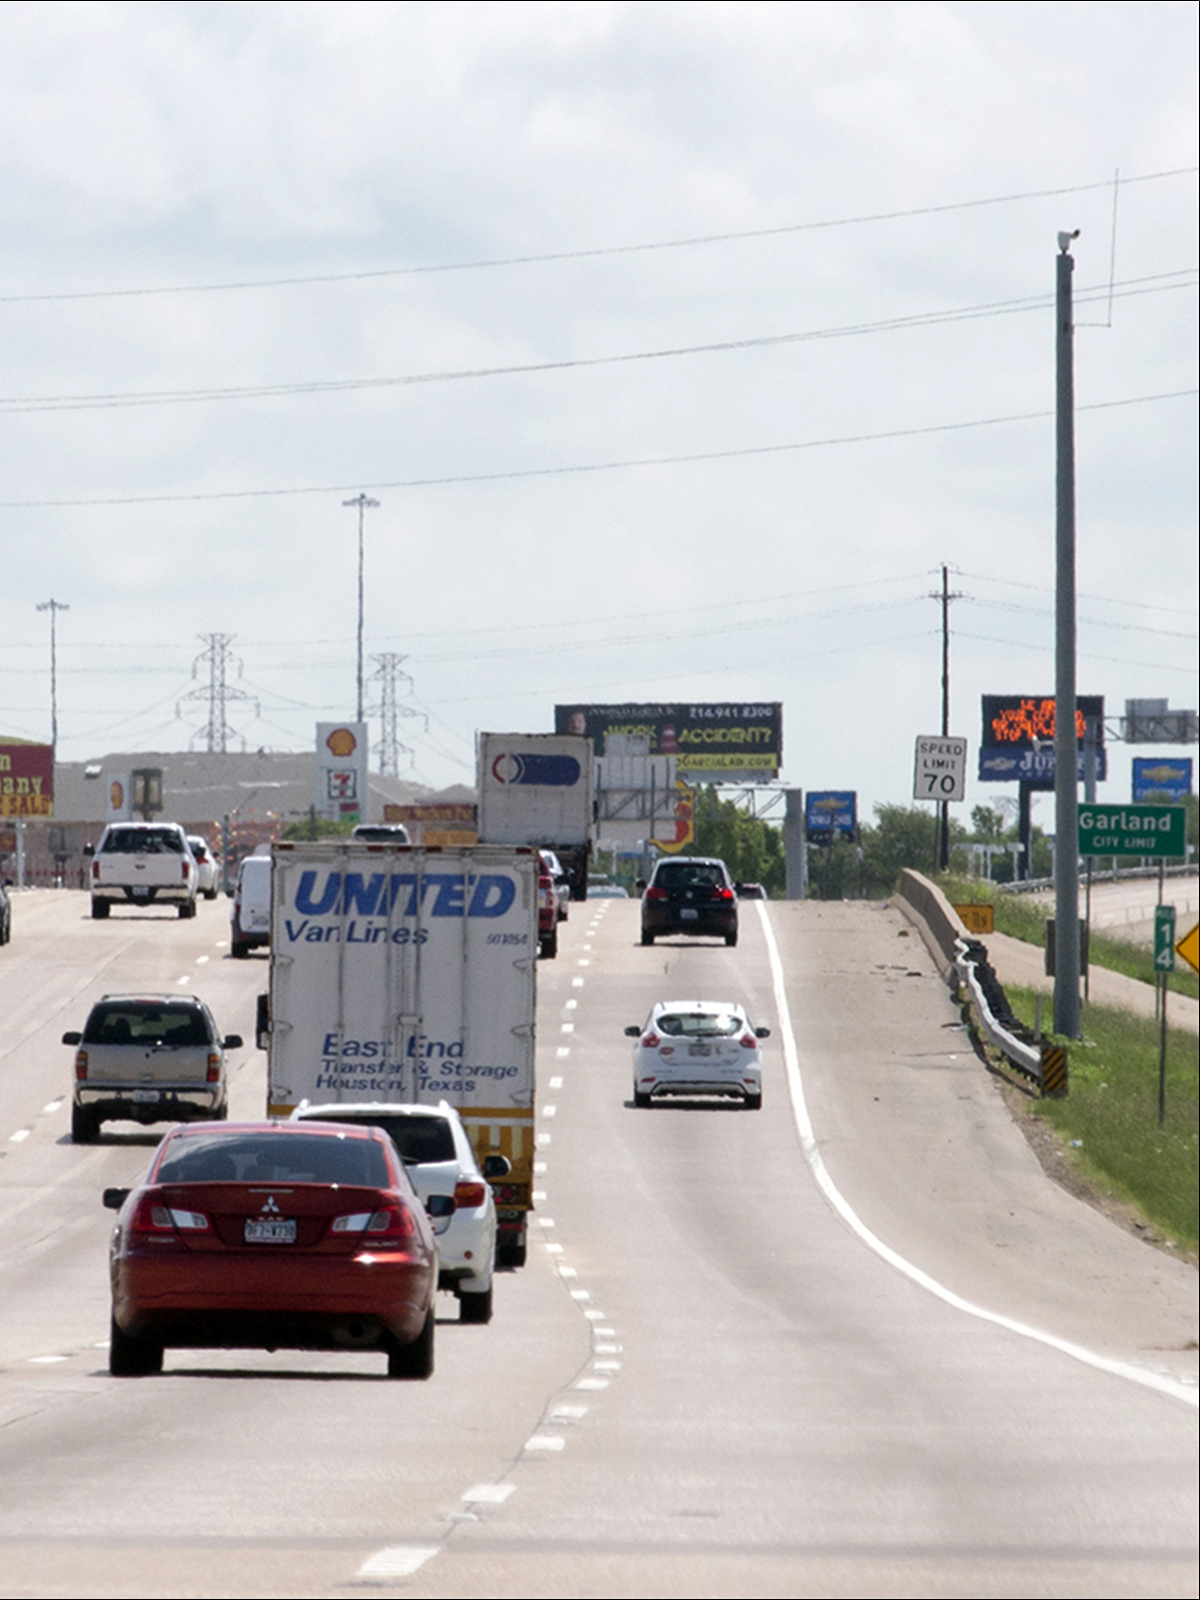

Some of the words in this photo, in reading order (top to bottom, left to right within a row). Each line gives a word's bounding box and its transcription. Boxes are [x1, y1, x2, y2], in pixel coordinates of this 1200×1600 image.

[678, 727, 772, 744] ACCIDENT?
[920, 741, 963, 755] SPEED
[923, 758, 956, 770] LIMIT
[923, 774, 956, 794] 70
[9, 796, 50, 815] SALE
[1079, 811, 1172, 832] Garland
[1092, 835, 1119, 848] CITY
[1124, 836, 1156, 849] LIMIT
[294, 870, 516, 918] UNITED
[284, 920, 340, 943] Van
[347, 920, 429, 945] Lines
[322, 1033, 393, 1058] East
[407, 1035, 465, 1058] End
[322, 1059, 403, 1075] Transfer
[412, 1060, 429, 1075] &
[439, 1060, 518, 1080] Storage
[419, 1075, 476, 1092] Texas
